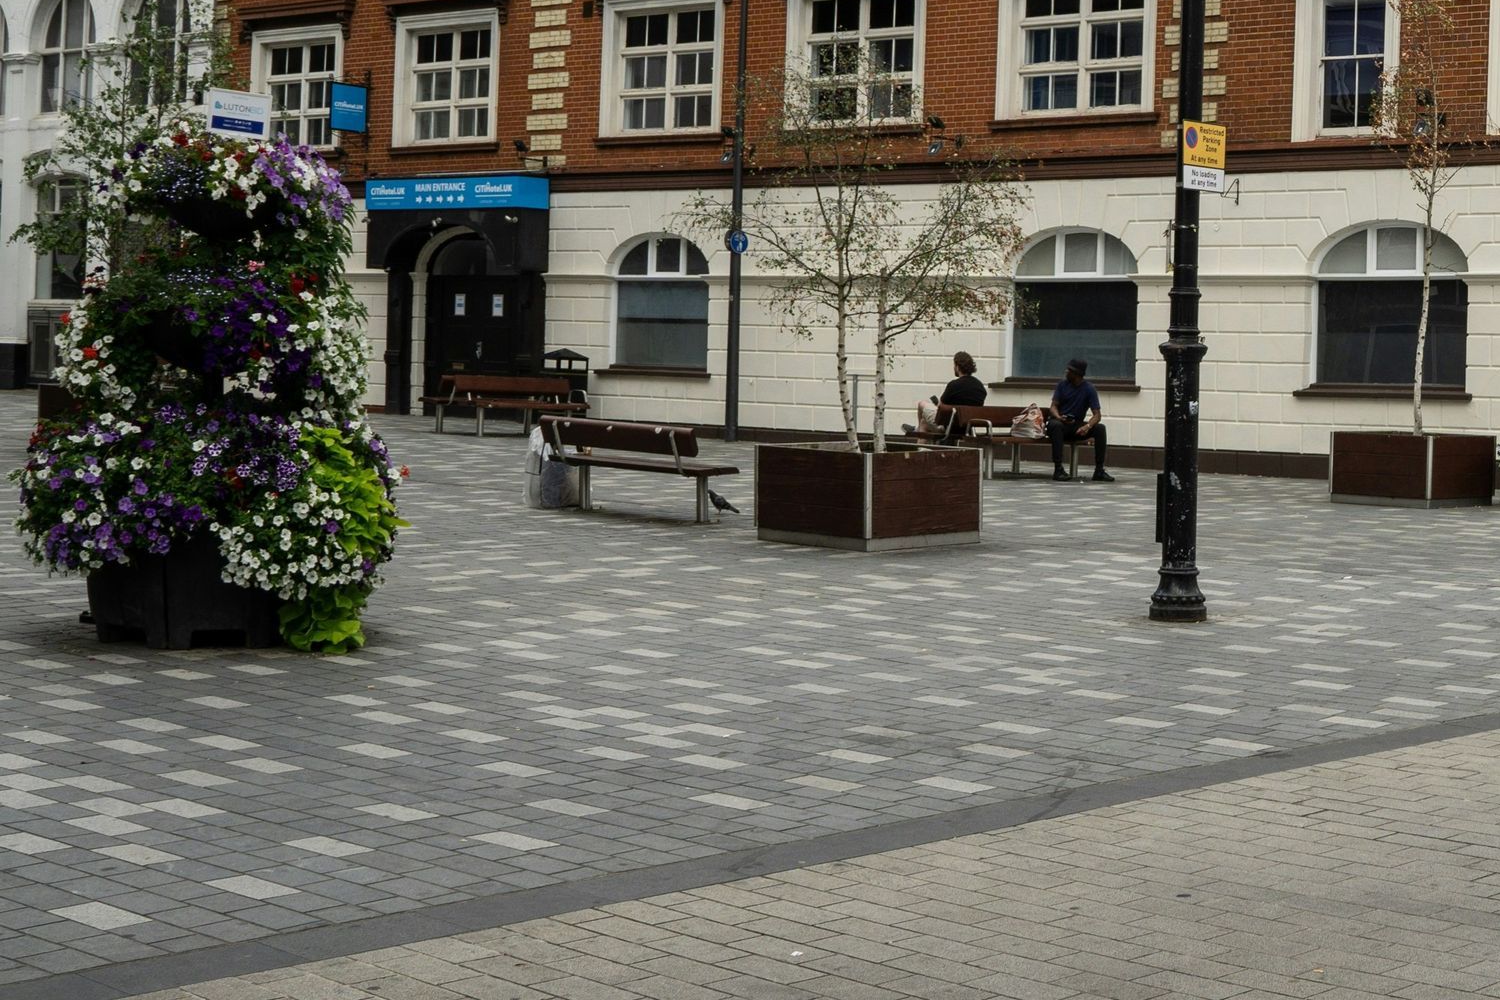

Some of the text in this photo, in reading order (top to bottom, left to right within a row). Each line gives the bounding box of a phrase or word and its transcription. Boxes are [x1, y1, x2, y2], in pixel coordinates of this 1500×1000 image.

[1199, 126, 1225, 137] Restricted
[1202, 135, 1221, 146] Parking
[1205, 145, 1218, 153] Zone
[1191, 154, 1197, 162] At
[1207, 156, 1218, 165] time
[1191, 169, 1217, 180] No loading
[415, 183, 431, 192] MAIN
[432, 182, 466, 192] ENTRANCE
[1197, 180, 1206, 188] any
[1206, 180, 1217, 188] time
